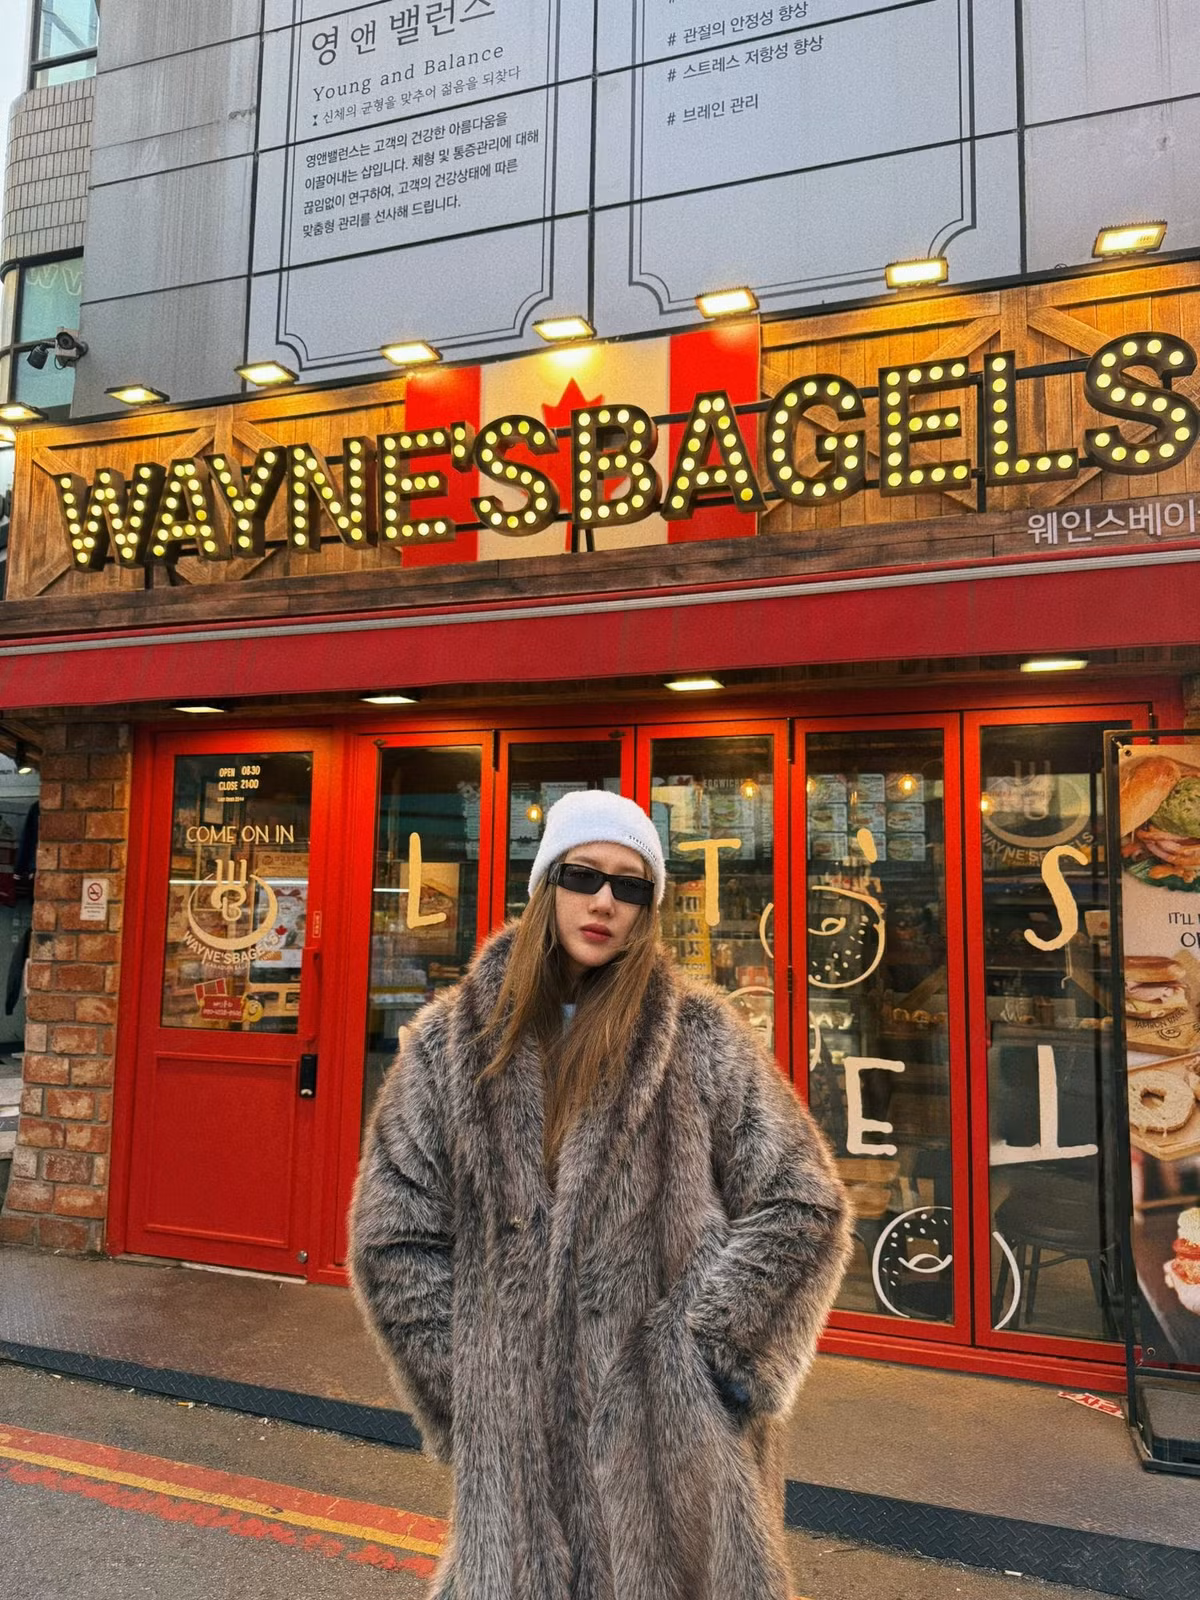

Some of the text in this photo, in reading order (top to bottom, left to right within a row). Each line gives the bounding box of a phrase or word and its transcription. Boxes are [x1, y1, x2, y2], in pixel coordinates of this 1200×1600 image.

[312, 0, 495, 66] 영 앤 밸런스
[683, 20, 726, 44] 관절의
[730, 9, 773, 33] 안정성
[778, 1, 808, 22] 향상
[313, 46, 504, 101] Young and Balance
[683, 55, 741, 79] 스트레스
[745, 42, 788, 65] 저항성
[794, 35, 824, 56] 향상
[323, 66, 522, 125] 신체의 균형을 맞추어 젊음을 되찾다
[682, 100, 725, 123] 브레인
[730, 93, 759, 114] 관리
[305, 129, 539, 191] 이끌어내는 샵입니다. 체형 및 통증관리에 대해
[306, 111, 508, 169] 영앤밸런스는 고객의 건강한 아름다움을
[304, 158, 518, 216] 끊임없이 연구하여, 고객의 건강상태에 따른
[303, 194, 461, 239] 맞춤형 관리를 선사해 드립니다.
[1028, 499, 1200, 545] 웨인스베이
[218, 767, 236, 777] OPEN
[218, 781, 238, 791] CLOSE
[186, 824, 294, 845] COME ON IN
